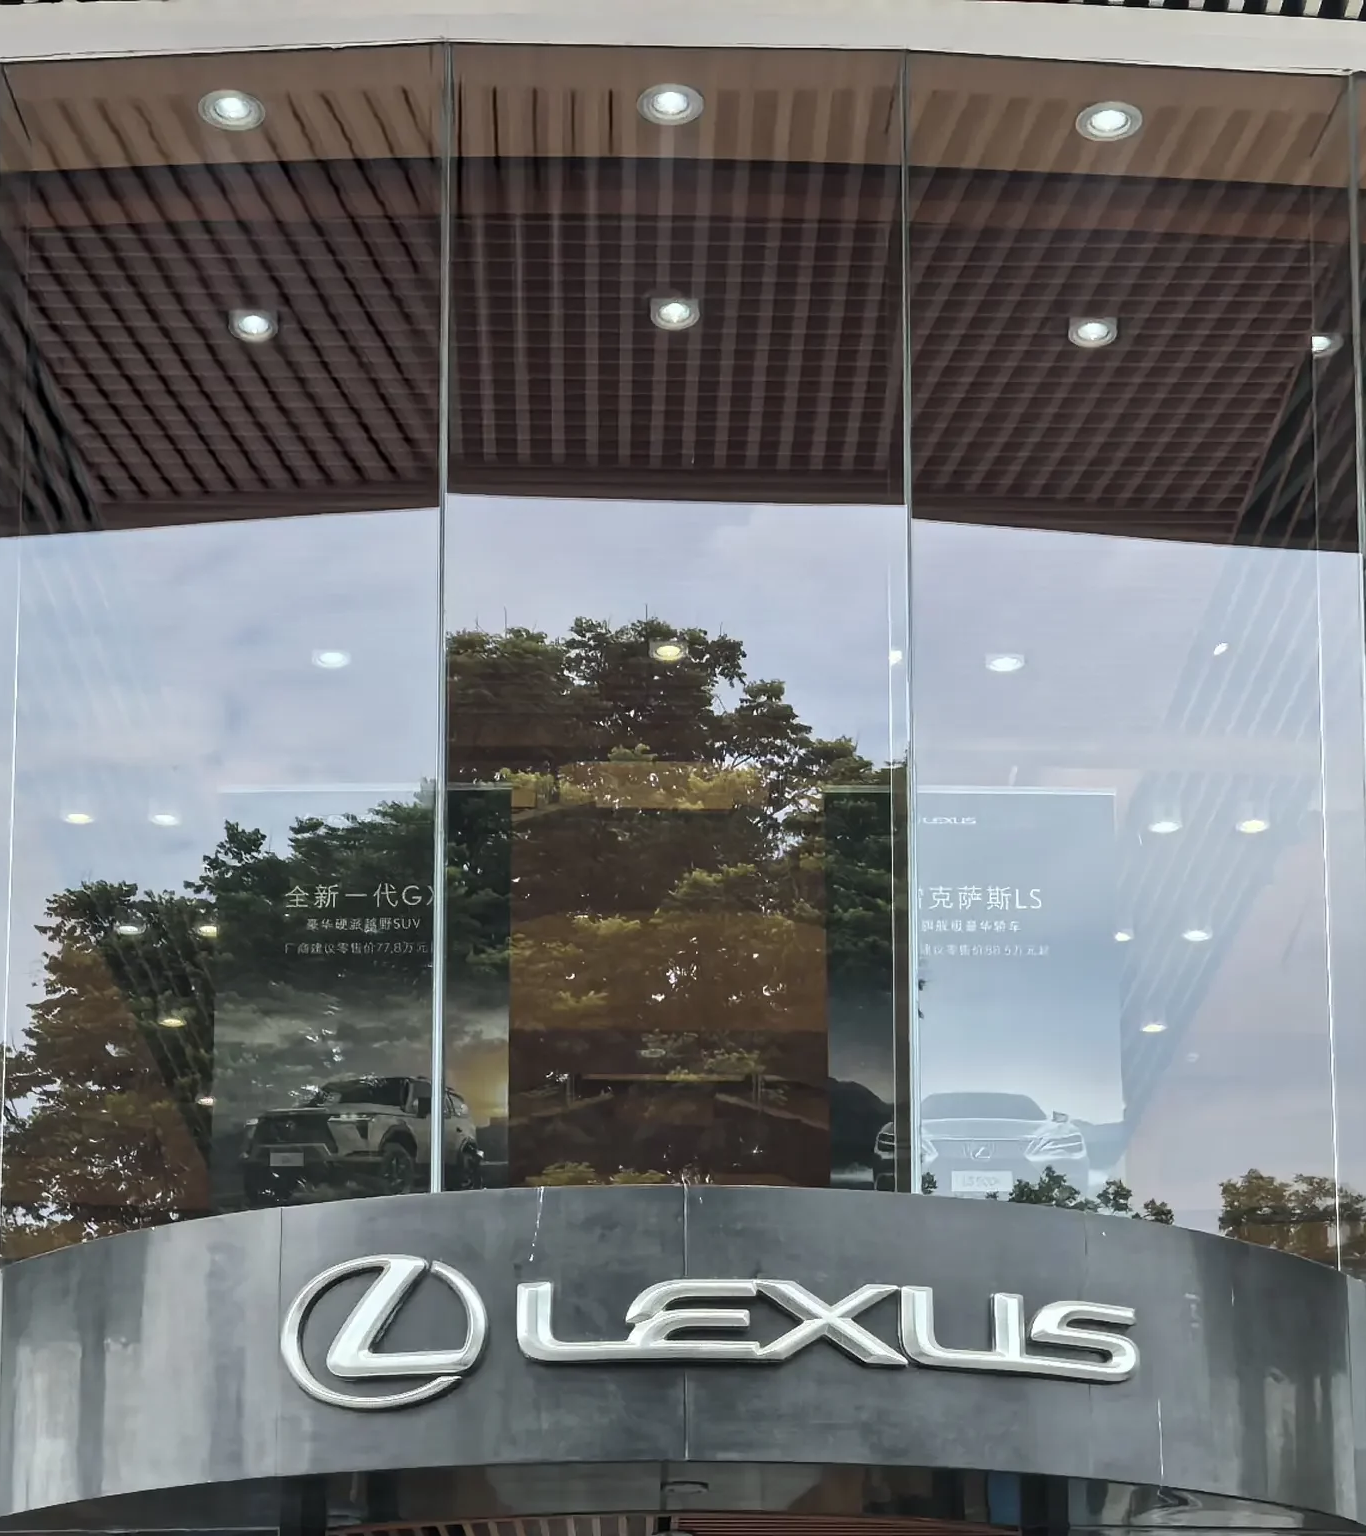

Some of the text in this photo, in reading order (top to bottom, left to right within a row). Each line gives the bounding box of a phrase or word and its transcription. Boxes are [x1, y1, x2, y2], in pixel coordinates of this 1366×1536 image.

[923, 816, 977, 825] LEXUS
[918, 885, 1042, 912] 克萨斯LS
[284, 942, 432, 955] 厂商建议零售价77.8万元
[515, 1277, 1141, 1384] LEXUS
